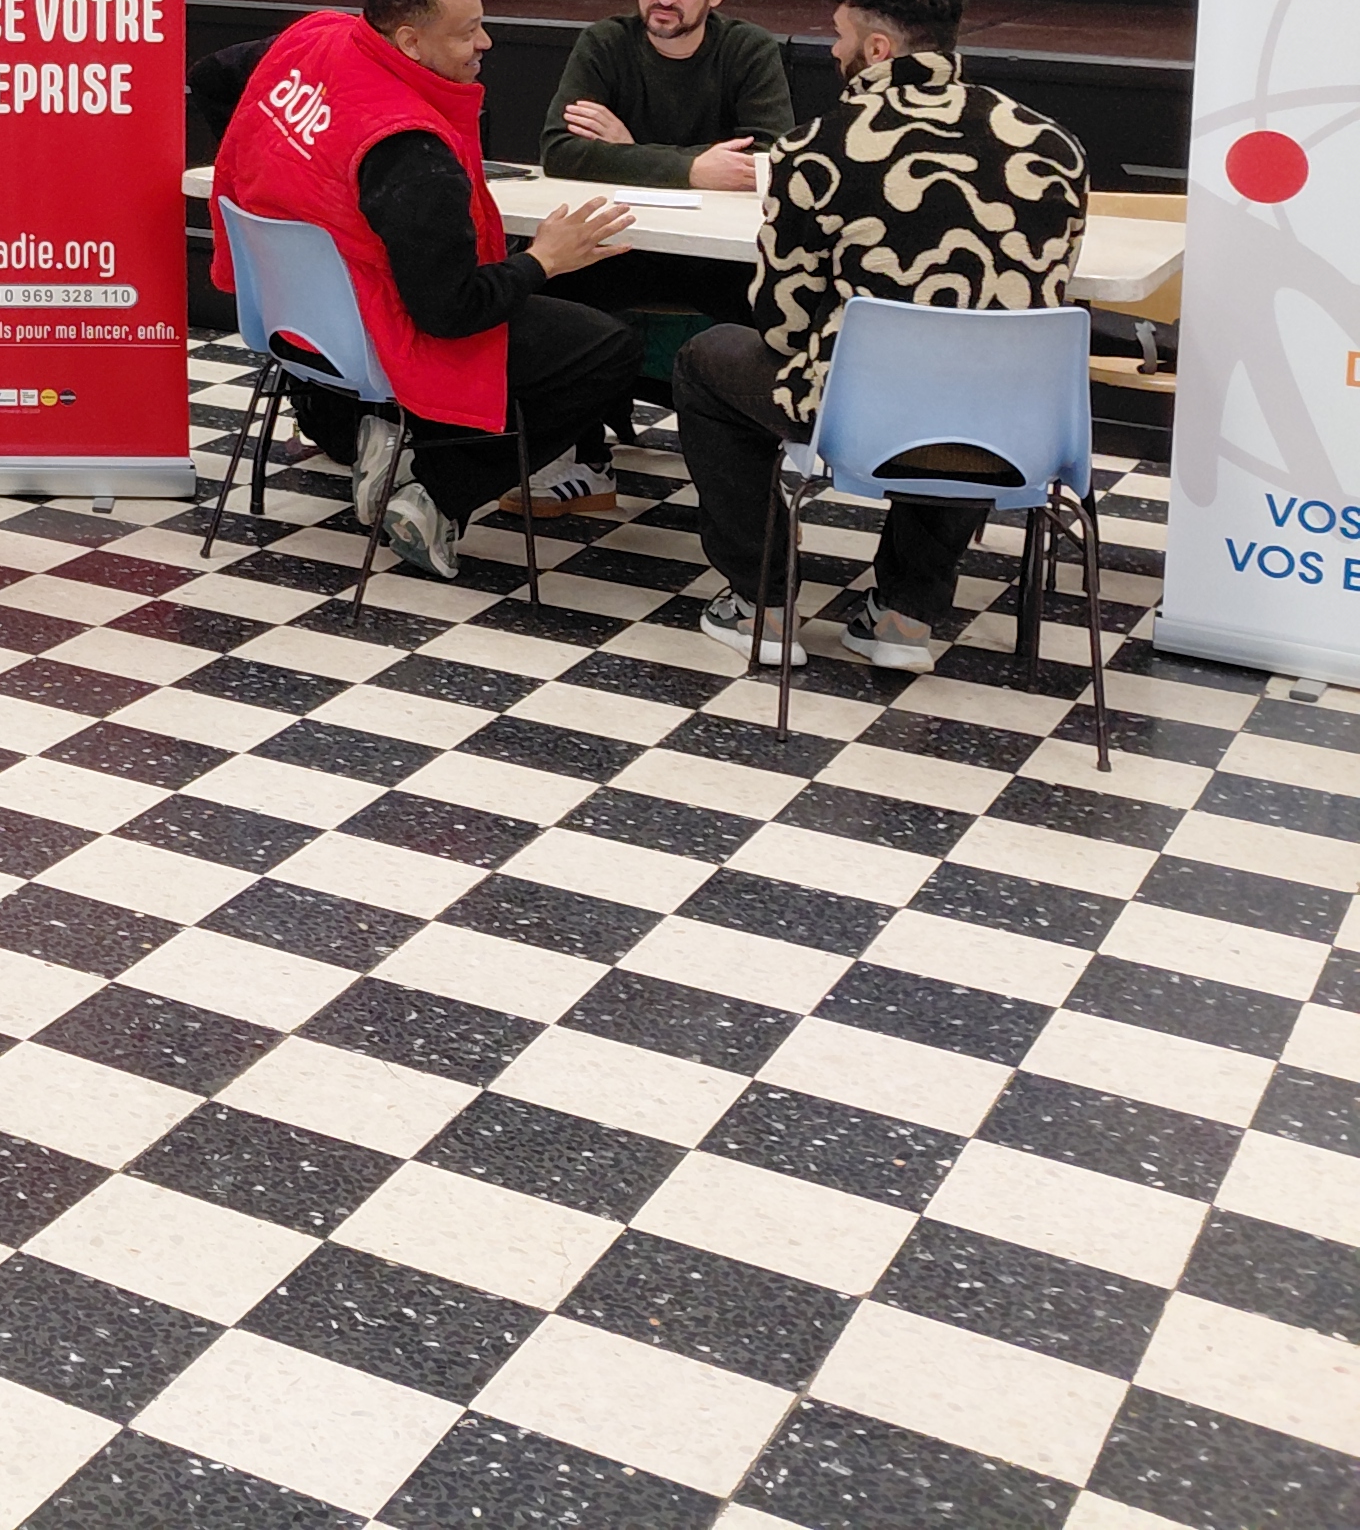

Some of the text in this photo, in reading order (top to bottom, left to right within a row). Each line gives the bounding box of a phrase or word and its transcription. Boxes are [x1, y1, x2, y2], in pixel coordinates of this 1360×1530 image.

[269, 68, 332, 146] adie
[4, 289, 15, 303] 0
[21, 289, 54, 303] 969
[61, 289, 93, 303] 328
[101, 289, 131, 303] 110
[16, 324, 52, 343] pour
[55, 324, 77, 339] me
[81, 321, 130, 342] lancer,
[137, 321, 181, 341] enfin.
[1264, 492, 1360, 540] VOS
[1223, 535, 1325, 585] VOS
